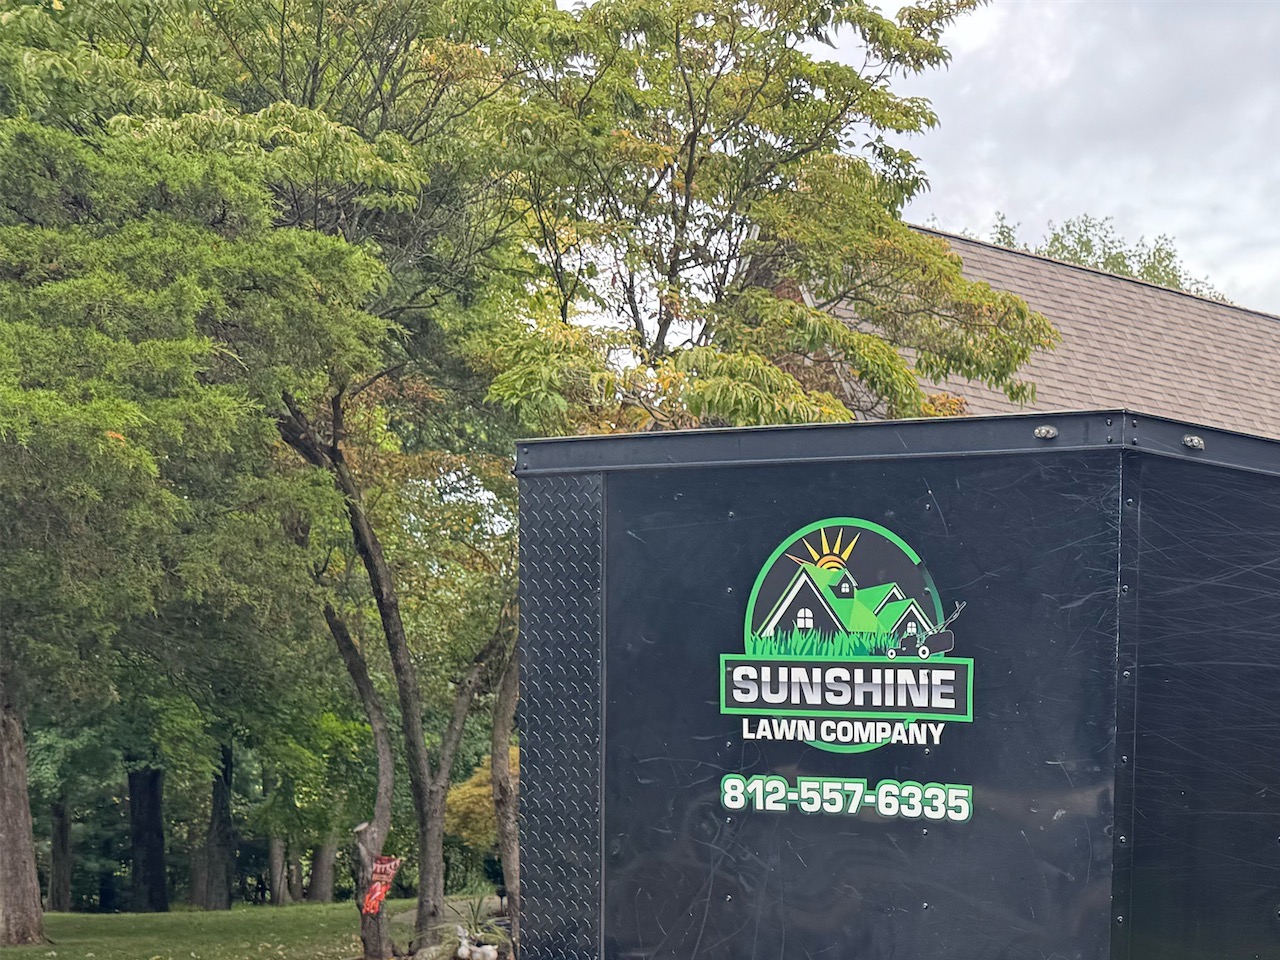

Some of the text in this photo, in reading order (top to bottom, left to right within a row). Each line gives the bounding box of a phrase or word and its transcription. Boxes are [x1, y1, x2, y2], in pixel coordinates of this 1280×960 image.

[731, 665, 956, 709] SUNSHINE
[742, 718, 945, 745] LAWN COMPANY
[723, 777, 970, 821] 812-557-6335
